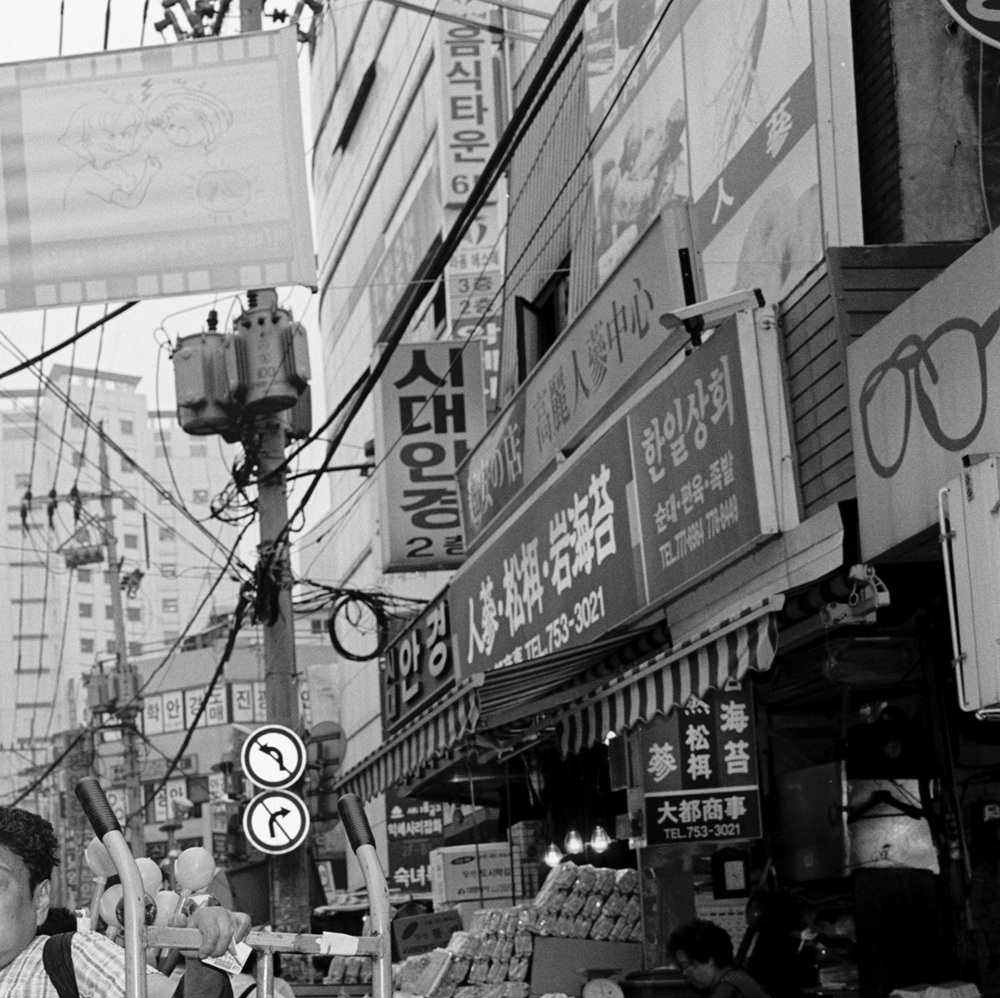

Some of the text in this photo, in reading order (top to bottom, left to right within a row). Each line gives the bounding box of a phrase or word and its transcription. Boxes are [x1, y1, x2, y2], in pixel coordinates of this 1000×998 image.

[444, 27, 490, 164] 음식타운
[394, 348, 468, 530] 시대안경
[641, 355, 735, 484] 한일상회
[657, 795, 748, 824] 大都商事
[663, 822, 741, 840] TEL.753-3021
